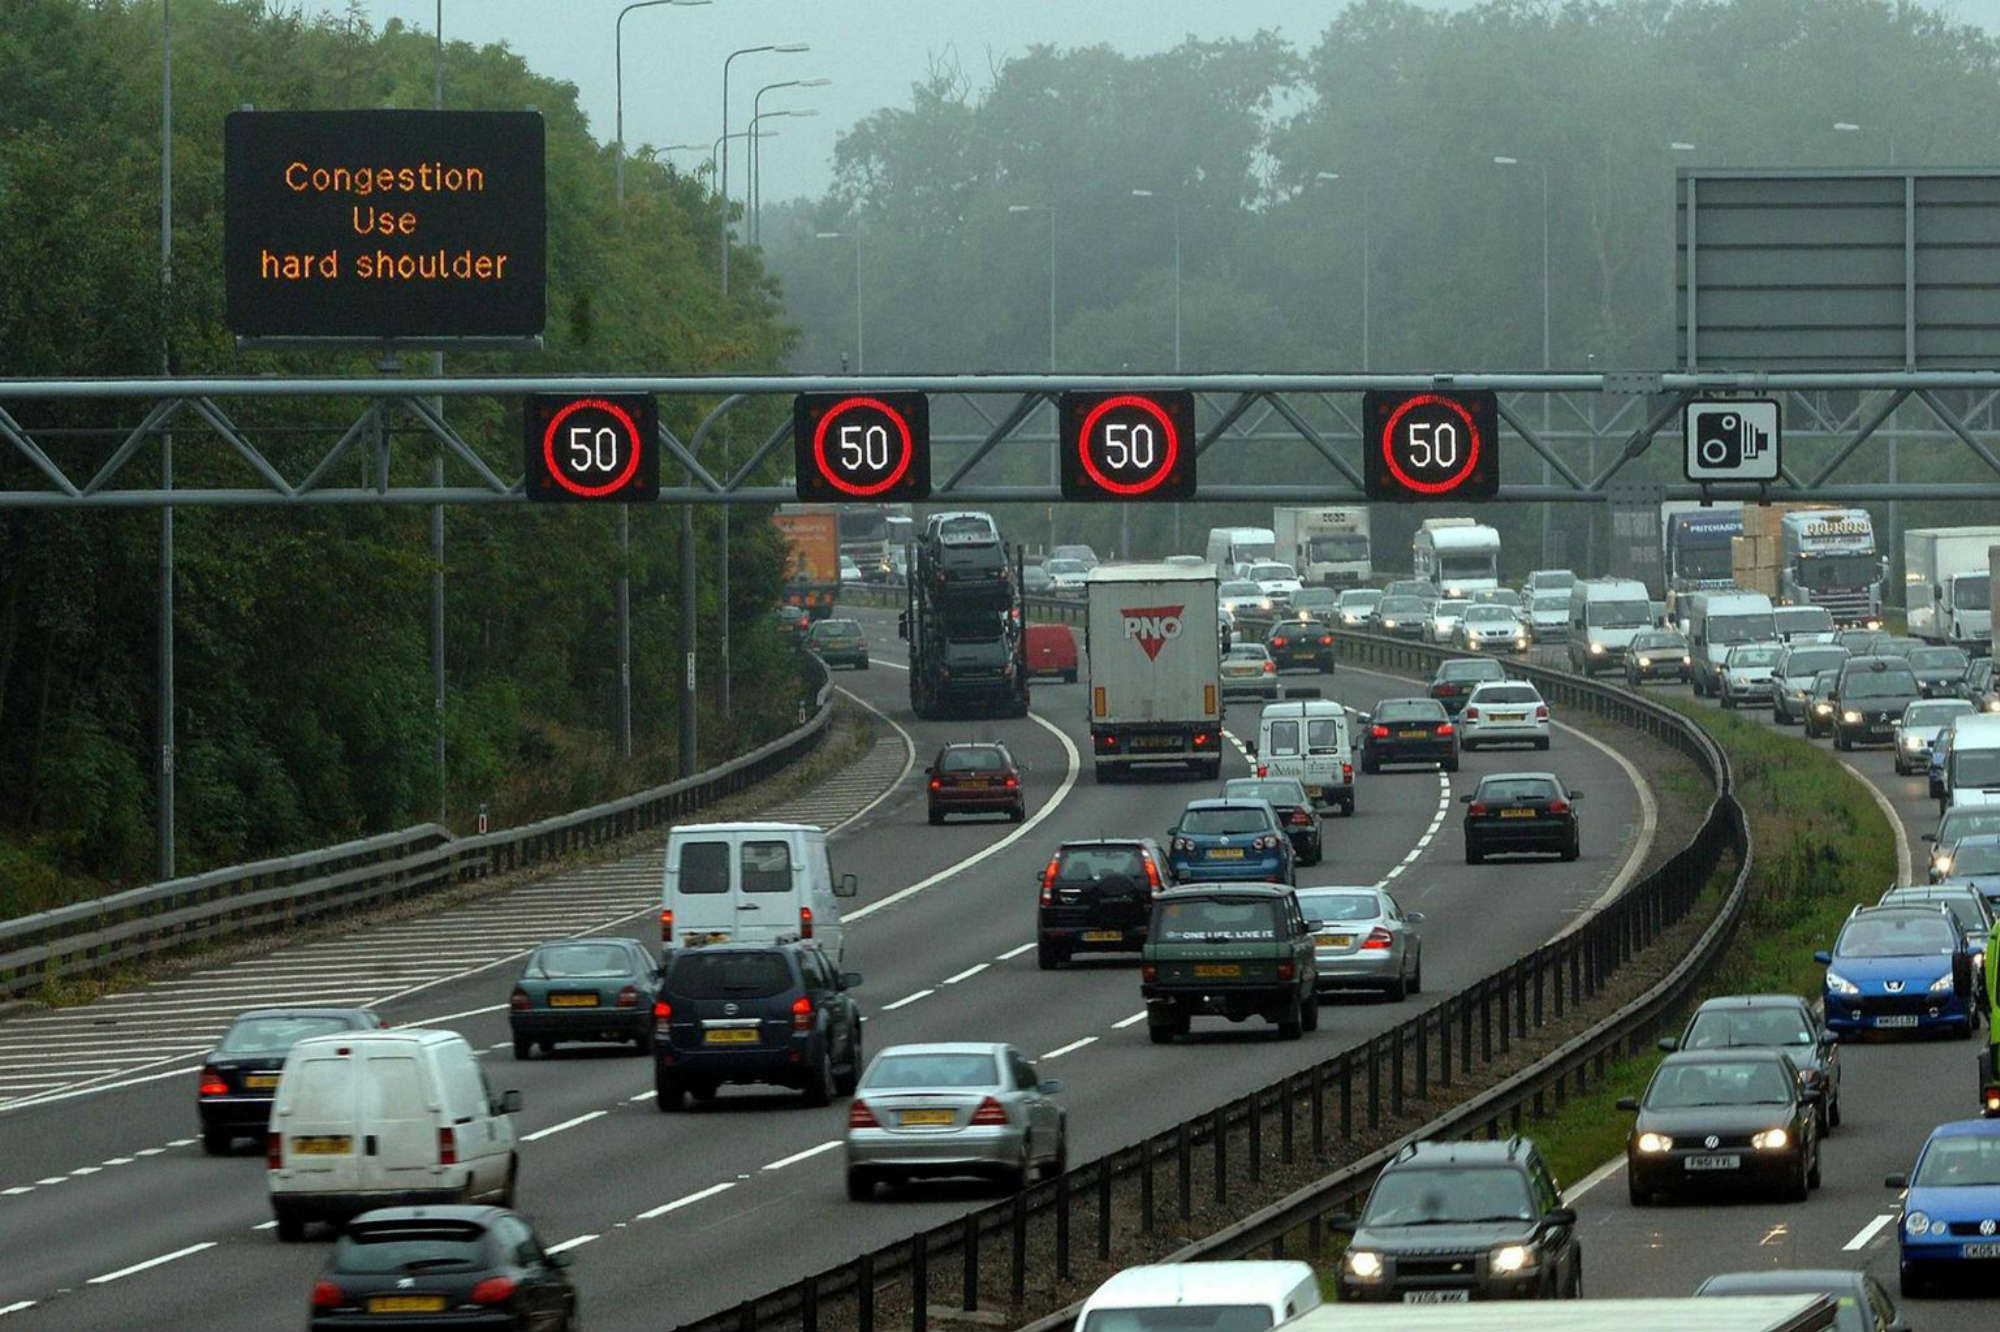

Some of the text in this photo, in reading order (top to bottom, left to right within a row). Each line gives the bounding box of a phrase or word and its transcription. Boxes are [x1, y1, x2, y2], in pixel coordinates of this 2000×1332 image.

[285, 162, 484, 195] Congestion
[353, 206, 417, 235] Use
[261, 249, 508, 279] hard shoulder
[570, 427, 617, 472] 50
[840, 425, 888, 471] 50
[1105, 423, 1154, 469] 50
[1409, 422, 1457, 468] 50
[1123, 615, 1183, 640] PNO
[1182, 930, 1206, 939] ONE
[1235, 930, 1260, 939] LIVE
